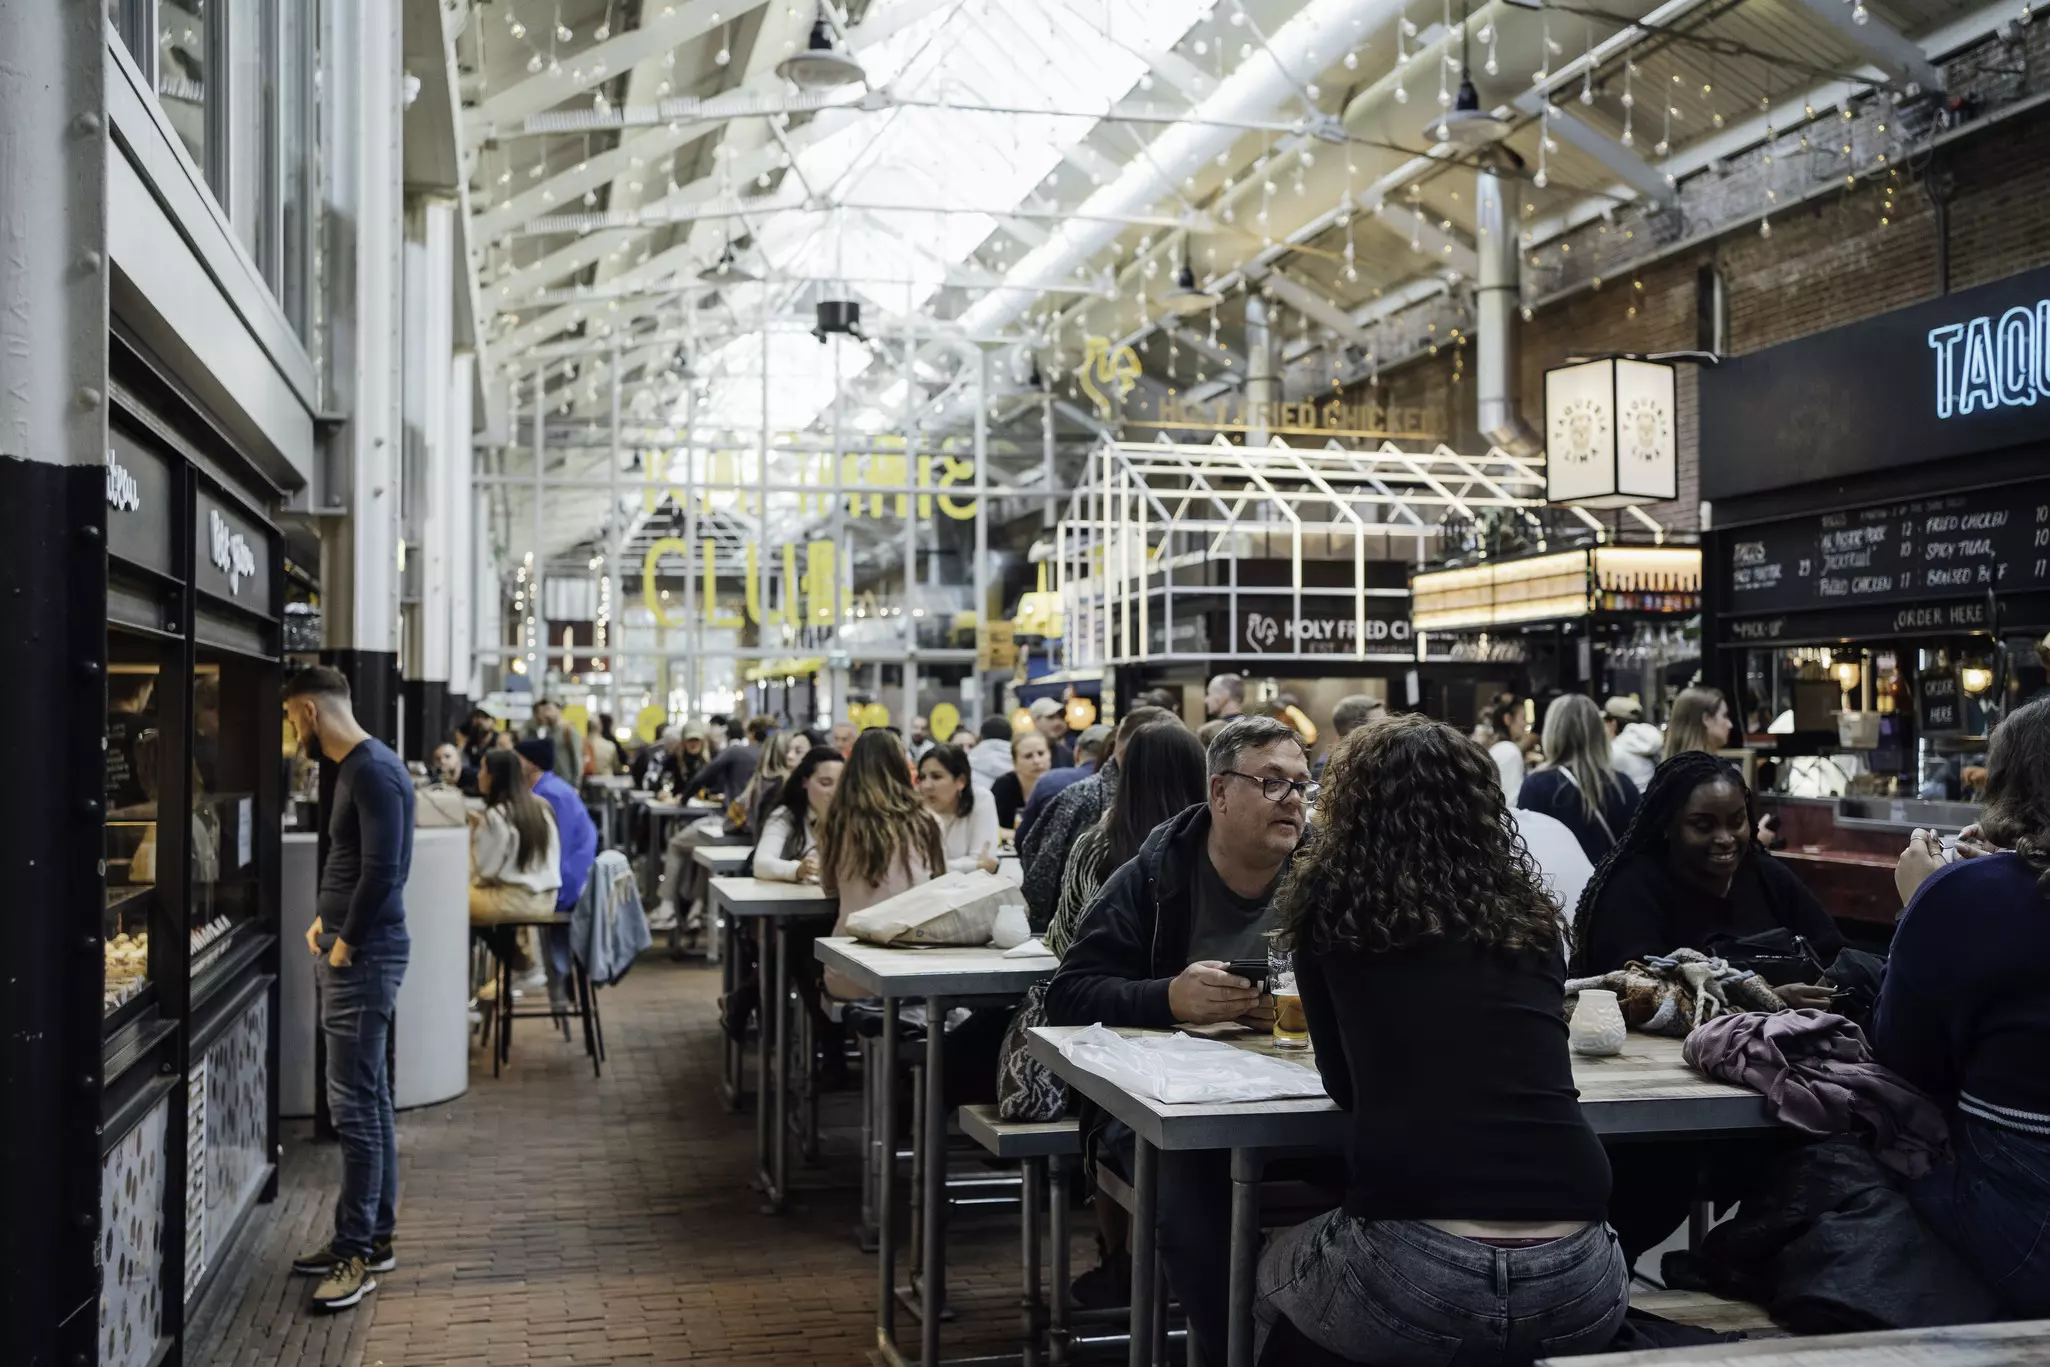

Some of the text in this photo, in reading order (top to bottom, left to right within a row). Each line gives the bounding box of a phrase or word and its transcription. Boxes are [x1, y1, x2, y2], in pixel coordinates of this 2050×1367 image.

[2035, 504, 2049, 523] 10
[2034, 527, 2049, 547] 10
[2034, 558, 2047, 578] 11
[1901, 571, 1911, 589] 11
[1898, 604, 1984, 627] ORDER HERE
[1337, 619, 1388, 640] FRED
[1930, 704, 1953, 723] HERE
